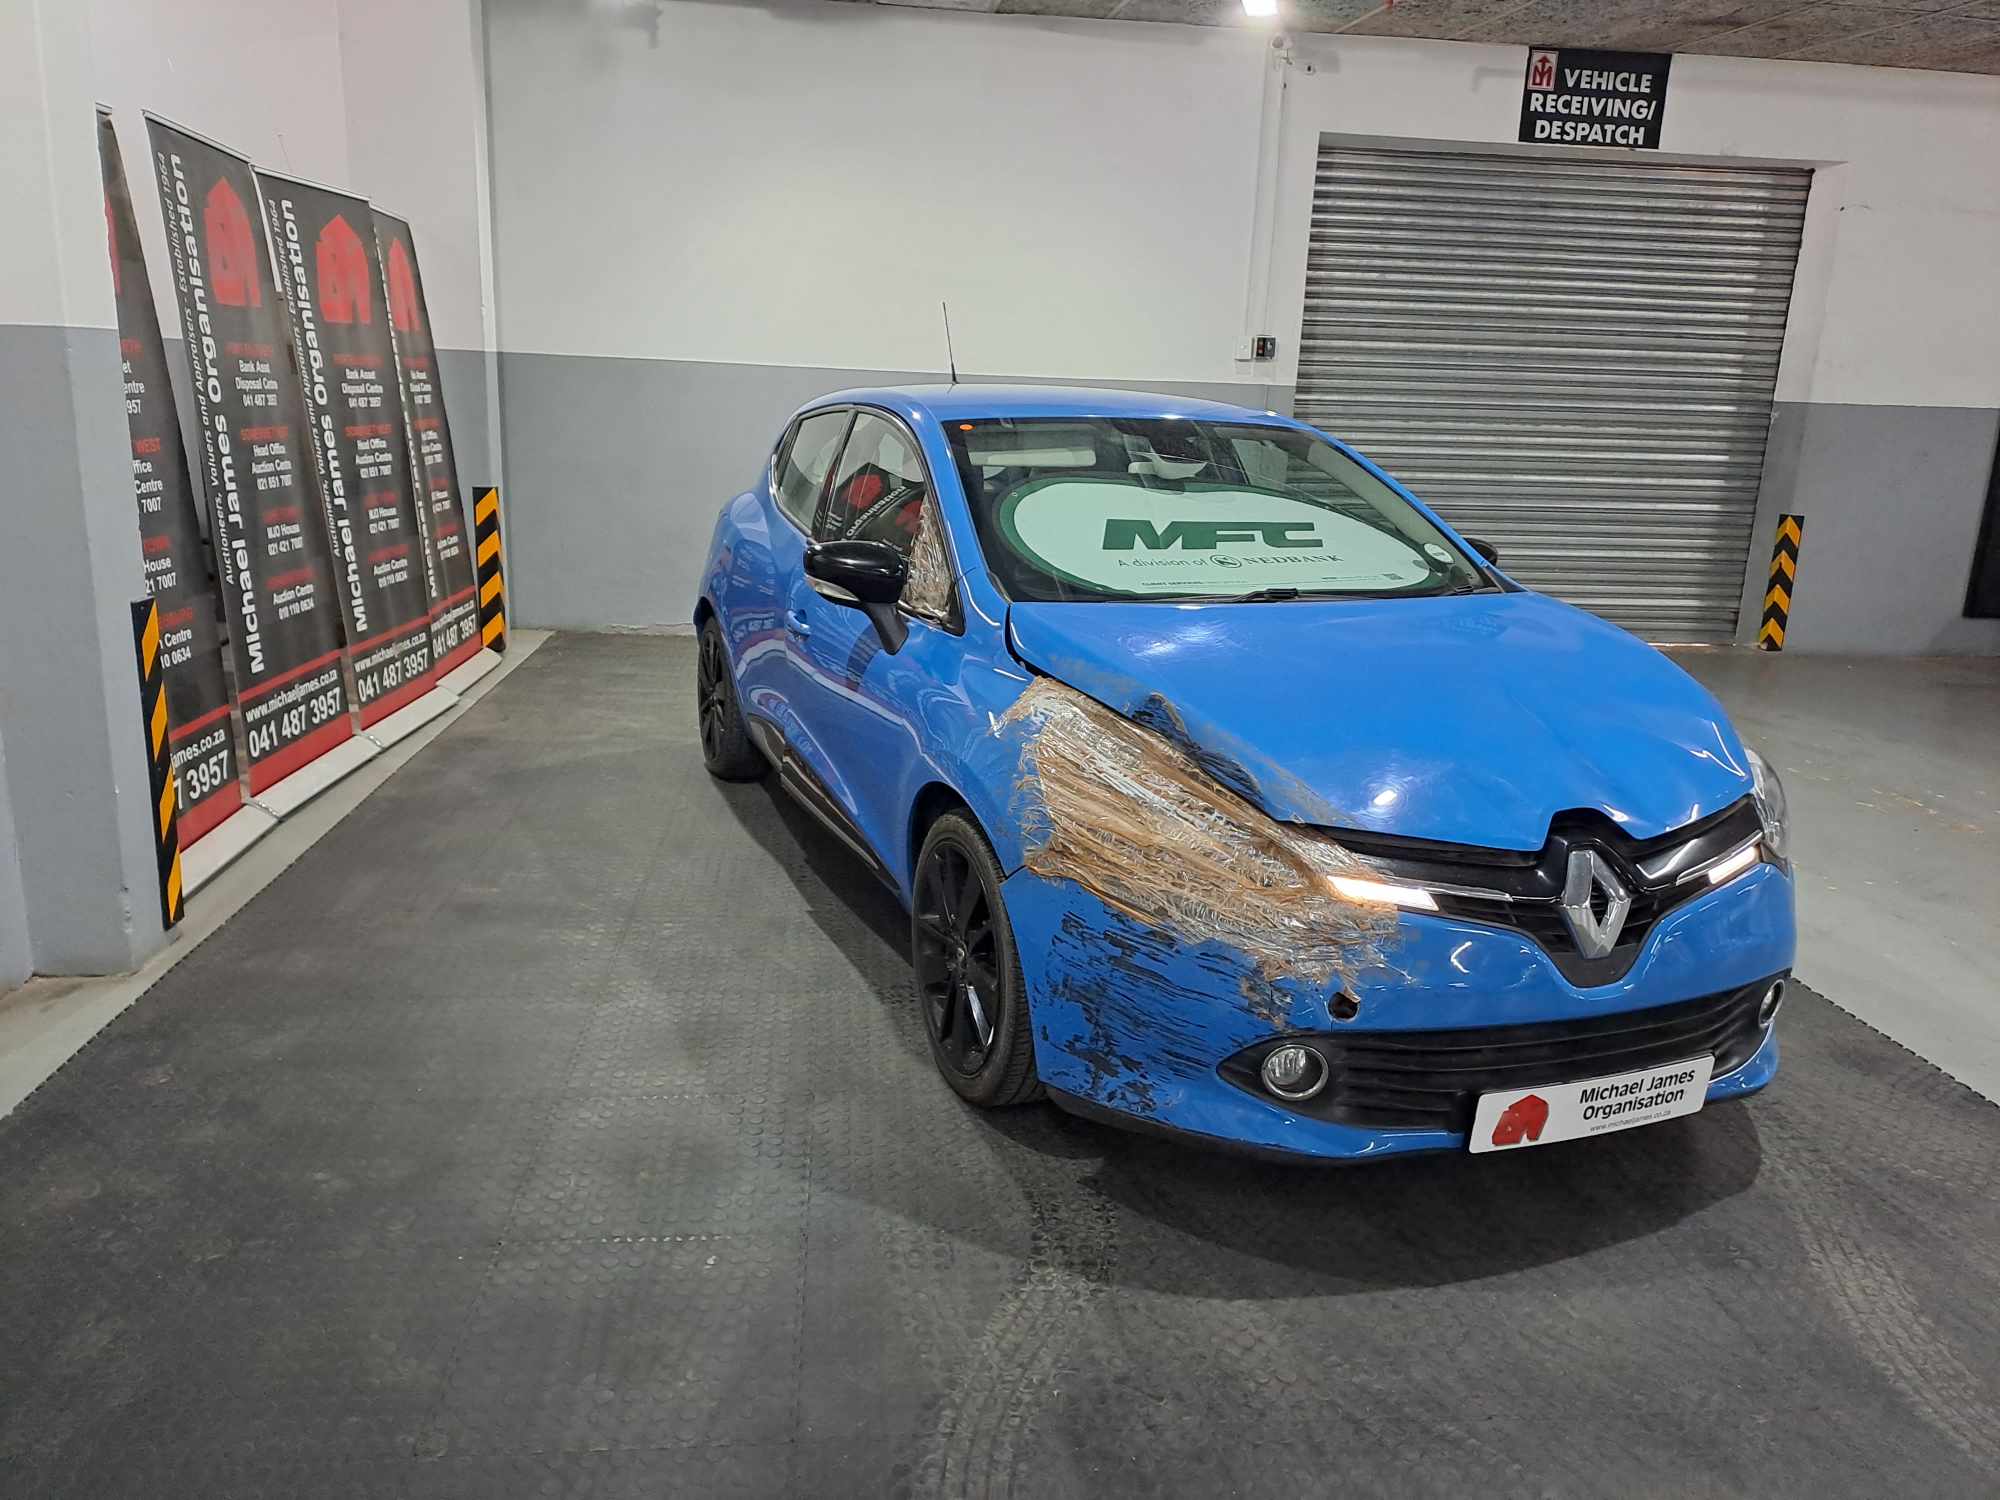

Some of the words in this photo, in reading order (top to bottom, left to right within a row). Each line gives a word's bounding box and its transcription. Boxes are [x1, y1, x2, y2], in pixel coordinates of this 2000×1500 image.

[1564, 67, 1653, 94] VEHICLE
[1529, 92, 1657, 121] RECEIVING/
[1534, 119, 1646, 146] DESPATCH
[157, 151, 172, 193] 1964
[268, 199, 281, 233] 1964
[164, 197, 189, 293] Established
[170, 153, 222, 404] Organisation
[281, 199, 328, 405] Organisation
[184, 306, 205, 392] Appraisers
[123, 380, 145, 395] entre
[126, 400, 142, 415] 957
[197, 394, 210, 426] and
[132, 459, 153, 474] ffice
[204, 429, 220, 487] Valuers
[214, 414, 244, 530] James
[320, 414, 348, 511] James
[134, 479, 164, 494] Centre
[140, 496, 162, 514] 7007
[214, 492, 235, 585] Auctioneers,
[1102, 518, 1324, 550] MFC
[143, 556, 173, 574] House
[336, 518, 368, 633] Michael
[1117, 558, 1130, 568] A
[1132, 557, 1191, 568] division
[1192, 557, 1209, 568] of
[1242, 553, 1345, 565] NEDBANK
[144, 578, 156, 594] 21
[156, 572, 177, 591] 7007
[231, 539, 265, 674] Michael
[164, 628, 193, 648] Centre
[432, 632, 447, 659] 041
[446, 623, 459, 649] 487
[459, 612, 477, 640] 3957
[171, 645, 193, 663] 0634
[357, 671, 380, 702] 041
[382, 660, 402, 689] 487
[402, 646, 429, 679] 3957
[248, 719, 279, 759] 041
[281, 704, 307, 741] 487
[309, 686, 342, 725] 3957
[170, 728, 226, 776] james.co.za
[172, 778, 184, 810] 7
[186, 749, 229, 800] 3957
[1580, 1078, 1644, 1104] Michael
[1646, 1069, 1696, 1092] James
[1582, 1088, 1685, 1121] Organisation
